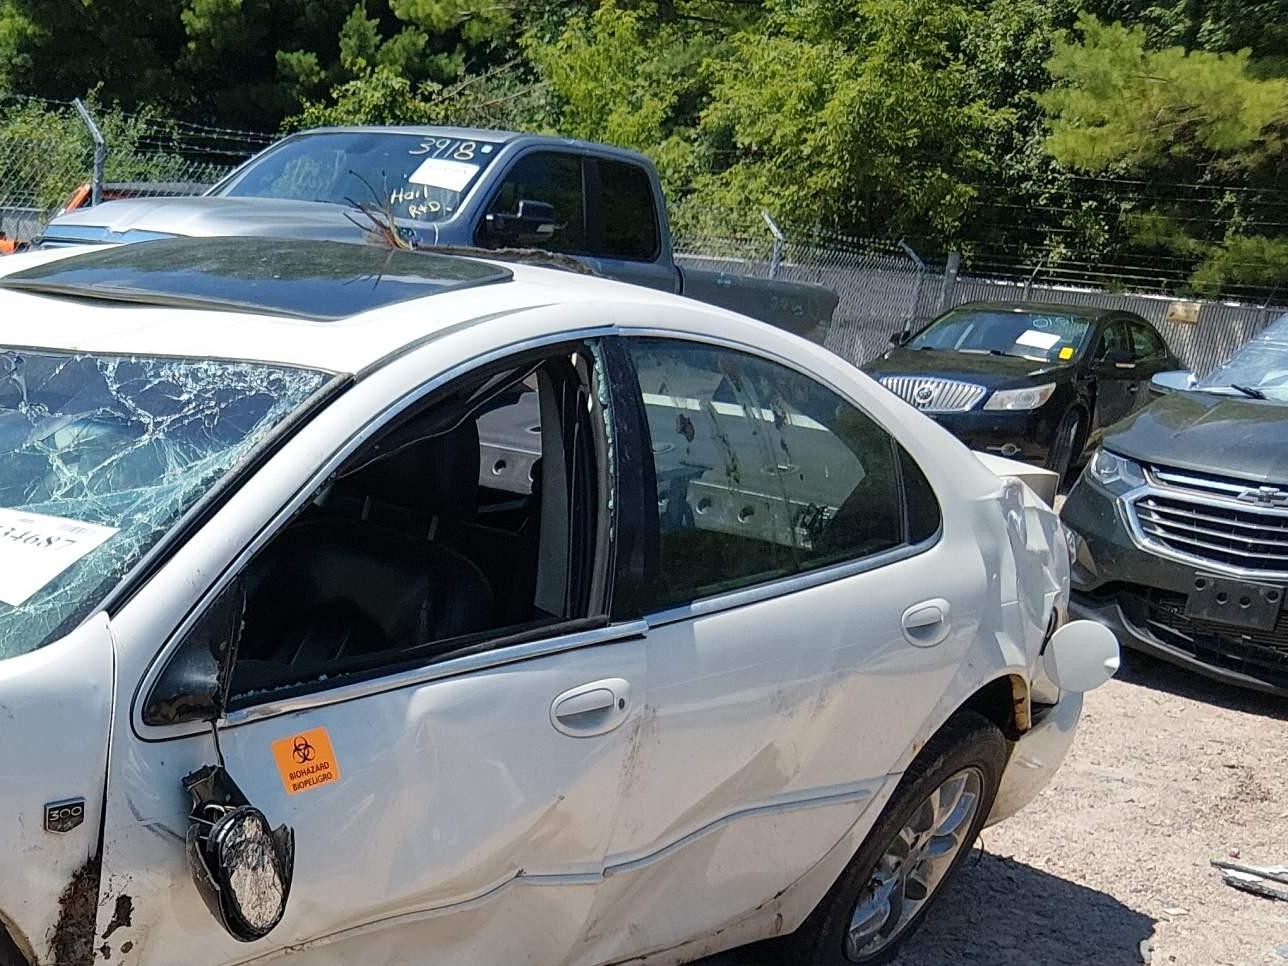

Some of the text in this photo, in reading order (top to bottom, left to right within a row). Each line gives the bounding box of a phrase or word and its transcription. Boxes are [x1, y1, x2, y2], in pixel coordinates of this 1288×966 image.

[408, 137, 476, 160] 3918
[391, 185, 428, 204] Hail
[289, 761, 329, 781] BIOHAZARD
[292, 772, 333, 791] BIOPELIGRO
[49, 806, 82, 821] 300
